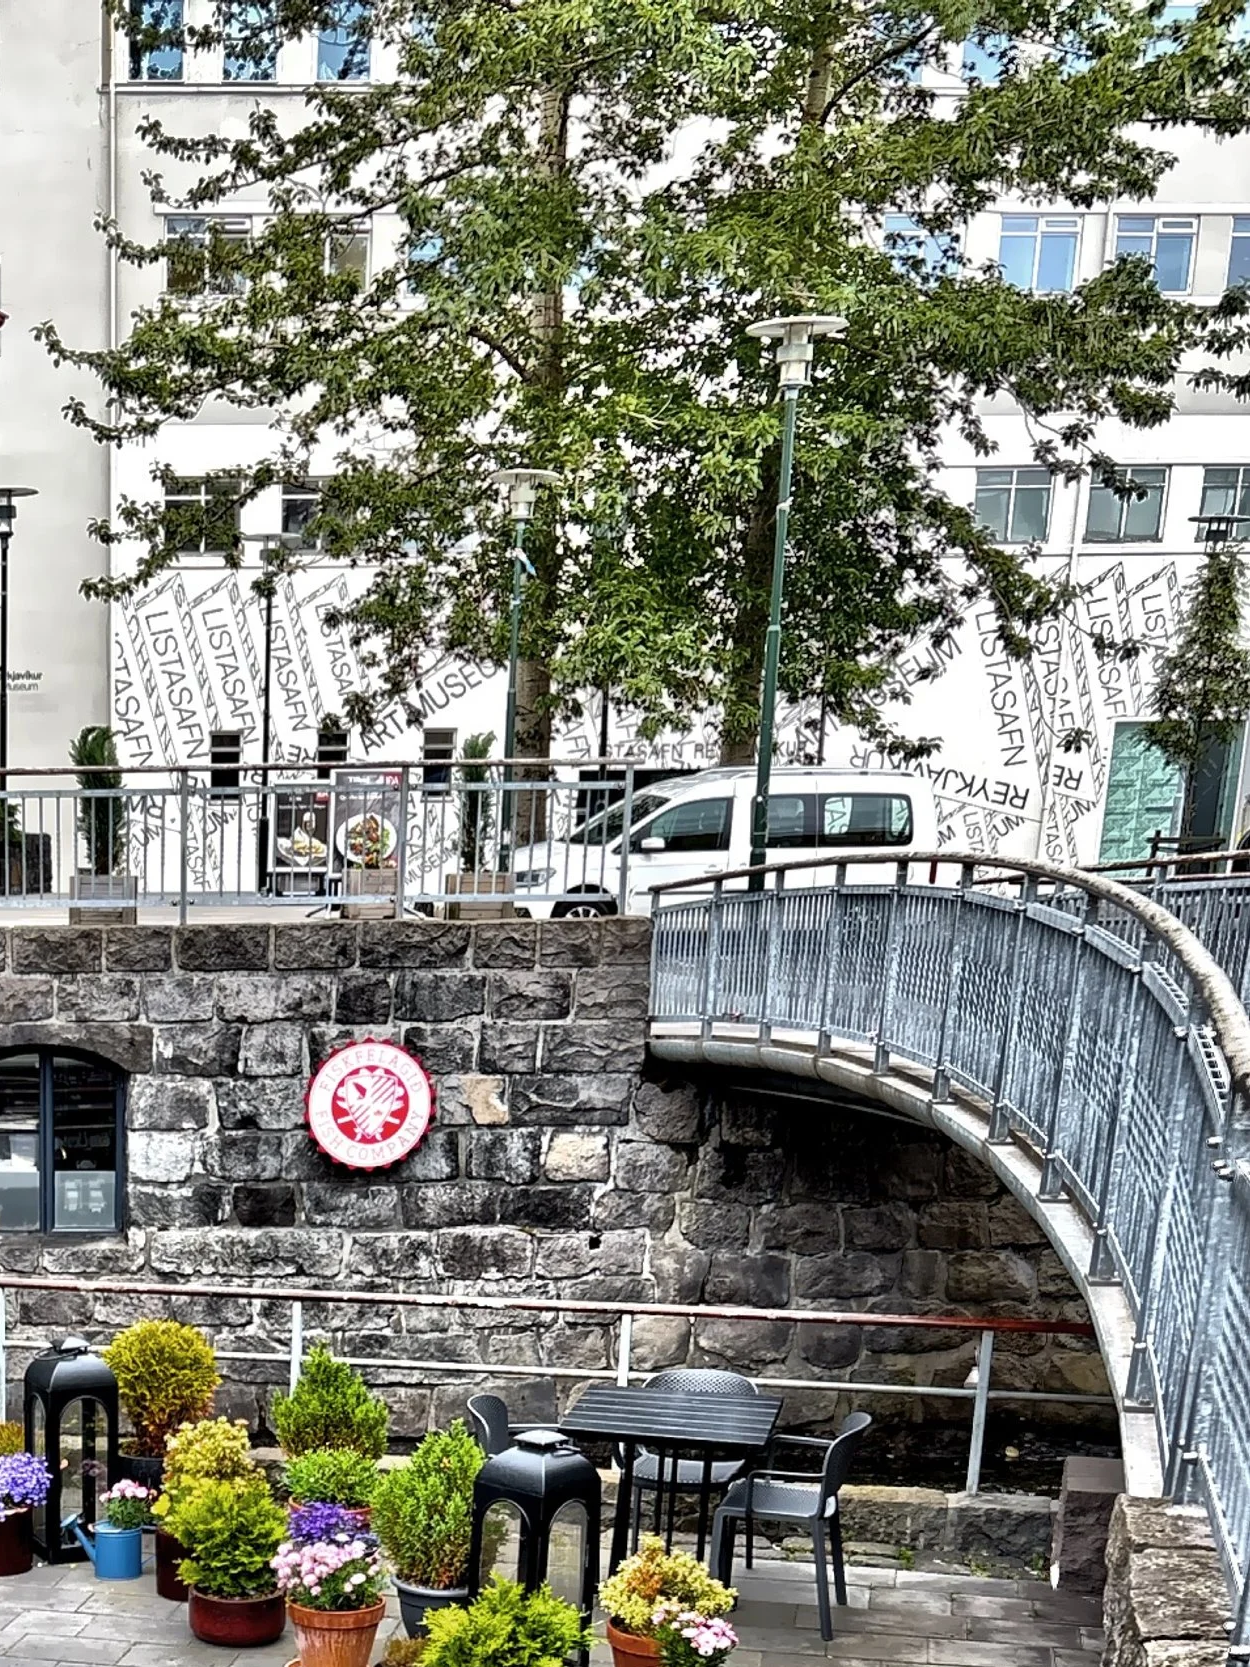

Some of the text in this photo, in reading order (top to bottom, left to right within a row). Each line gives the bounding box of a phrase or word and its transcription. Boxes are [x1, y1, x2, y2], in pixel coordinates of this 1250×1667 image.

[145, 610, 209, 760] LISTASAFN
[202, 608, 260, 745] LISTASAFN
[412, 655, 499, 720] MUSEU
[975, 609, 1028, 767] LISTASAFN
[315, 1110, 424, 1161] FISH COMPANY
